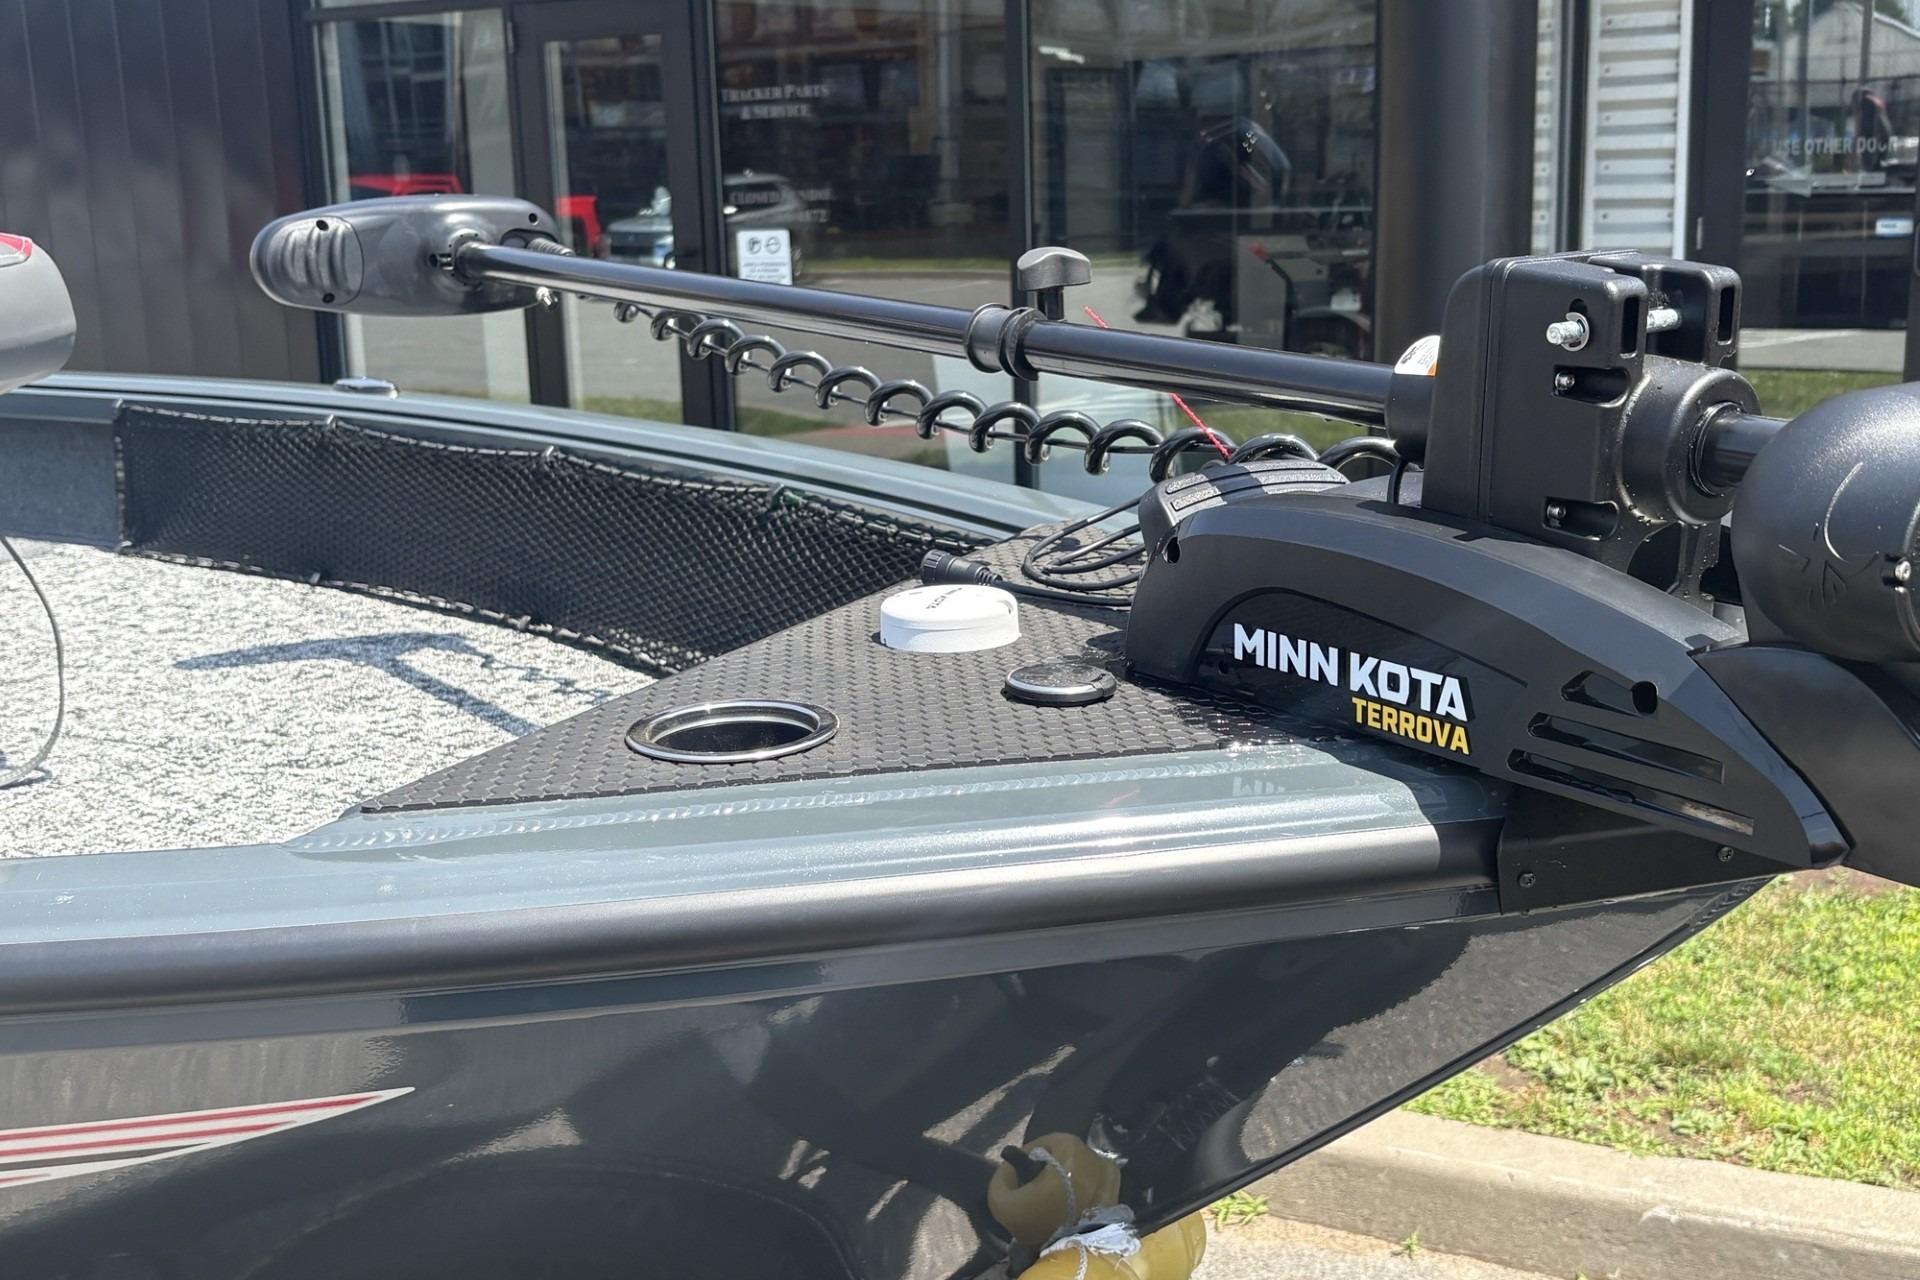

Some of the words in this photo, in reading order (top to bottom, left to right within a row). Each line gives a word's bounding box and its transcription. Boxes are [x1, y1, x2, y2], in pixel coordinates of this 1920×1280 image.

[1804, 137, 1852, 155] OTHER
[1234, 623, 1338, 687] MINN
[1350, 651, 1468, 722] KOTA
[1352, 697, 1469, 755] TERROVA
